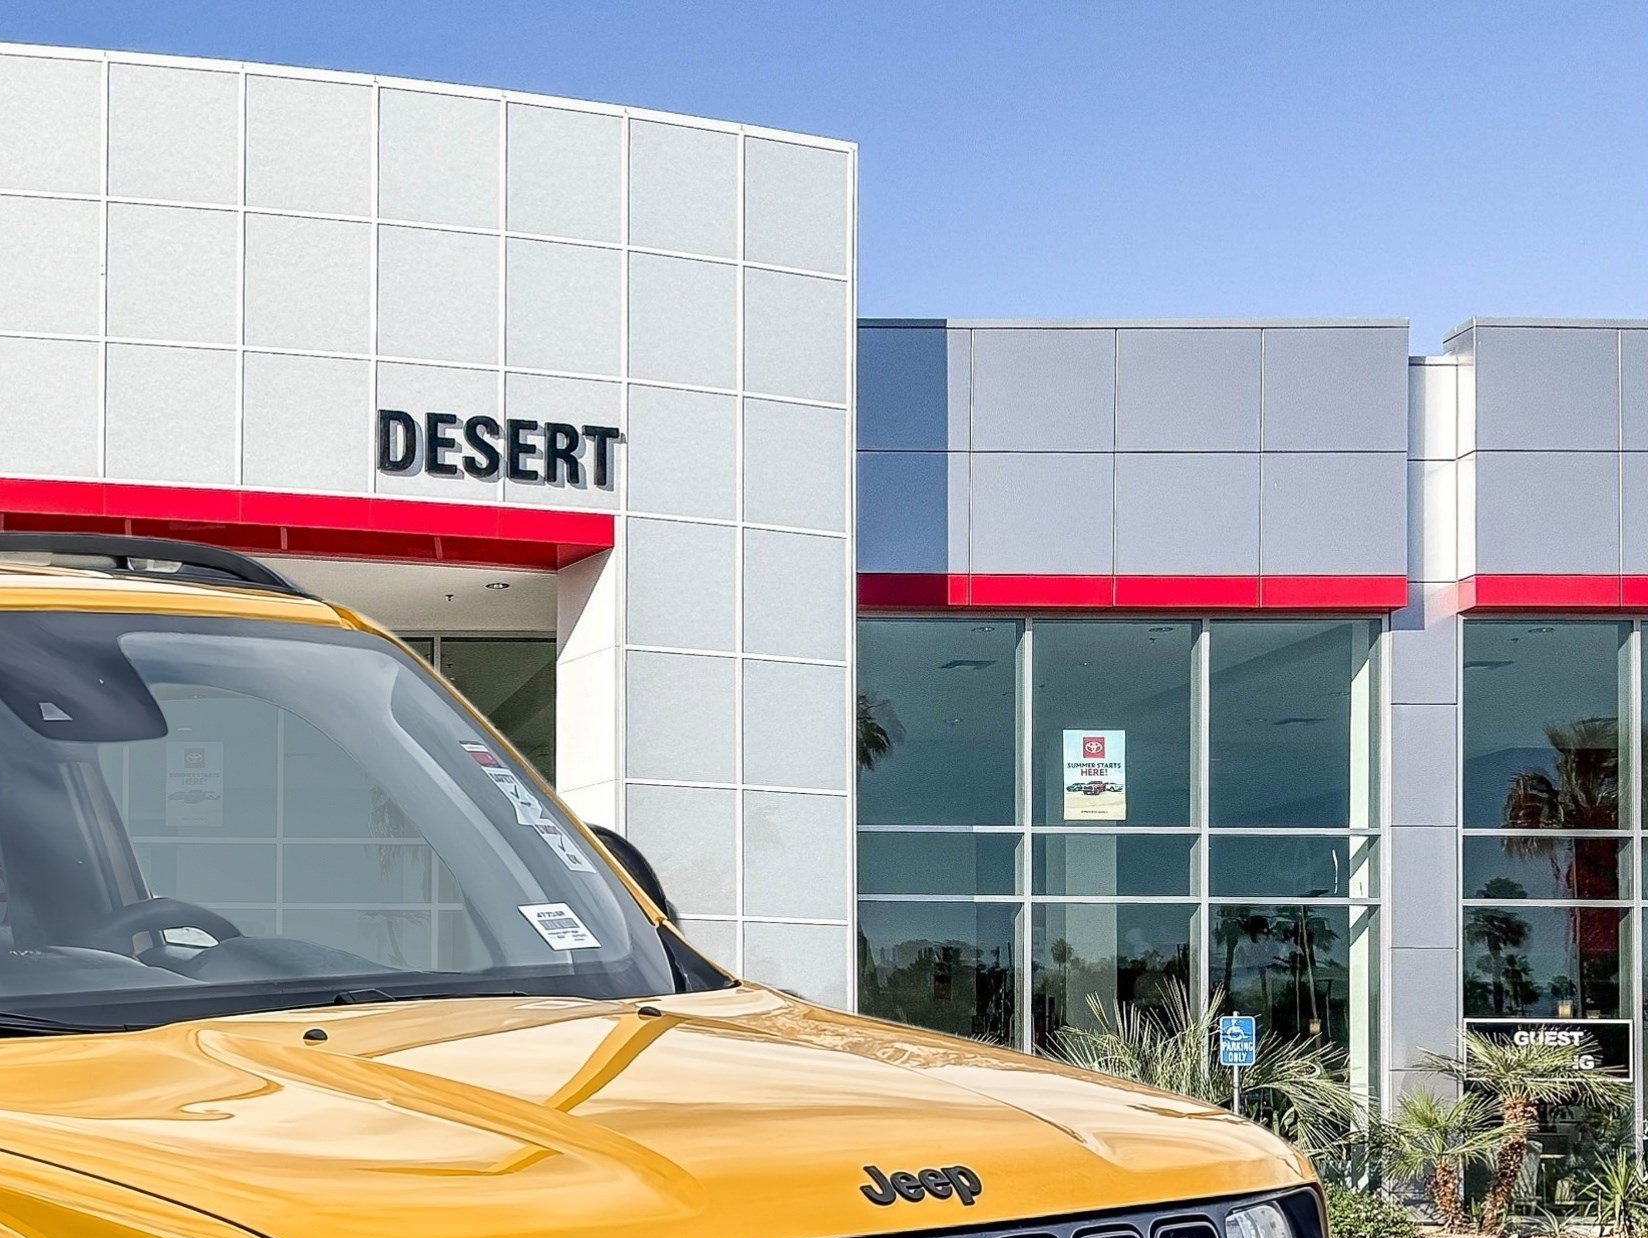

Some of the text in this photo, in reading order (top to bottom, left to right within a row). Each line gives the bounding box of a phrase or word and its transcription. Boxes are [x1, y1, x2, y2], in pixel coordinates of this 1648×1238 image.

[376, 409, 620, 486] DESERT
[1080, 769, 1108, 777] HERE!
[1513, 1030, 1584, 1047] GUEST
[1222, 1041, 1254, 1052] PARKING
[1228, 1052, 1248, 1062] ONLY
[859, 1165, 982, 1206] Jeep
